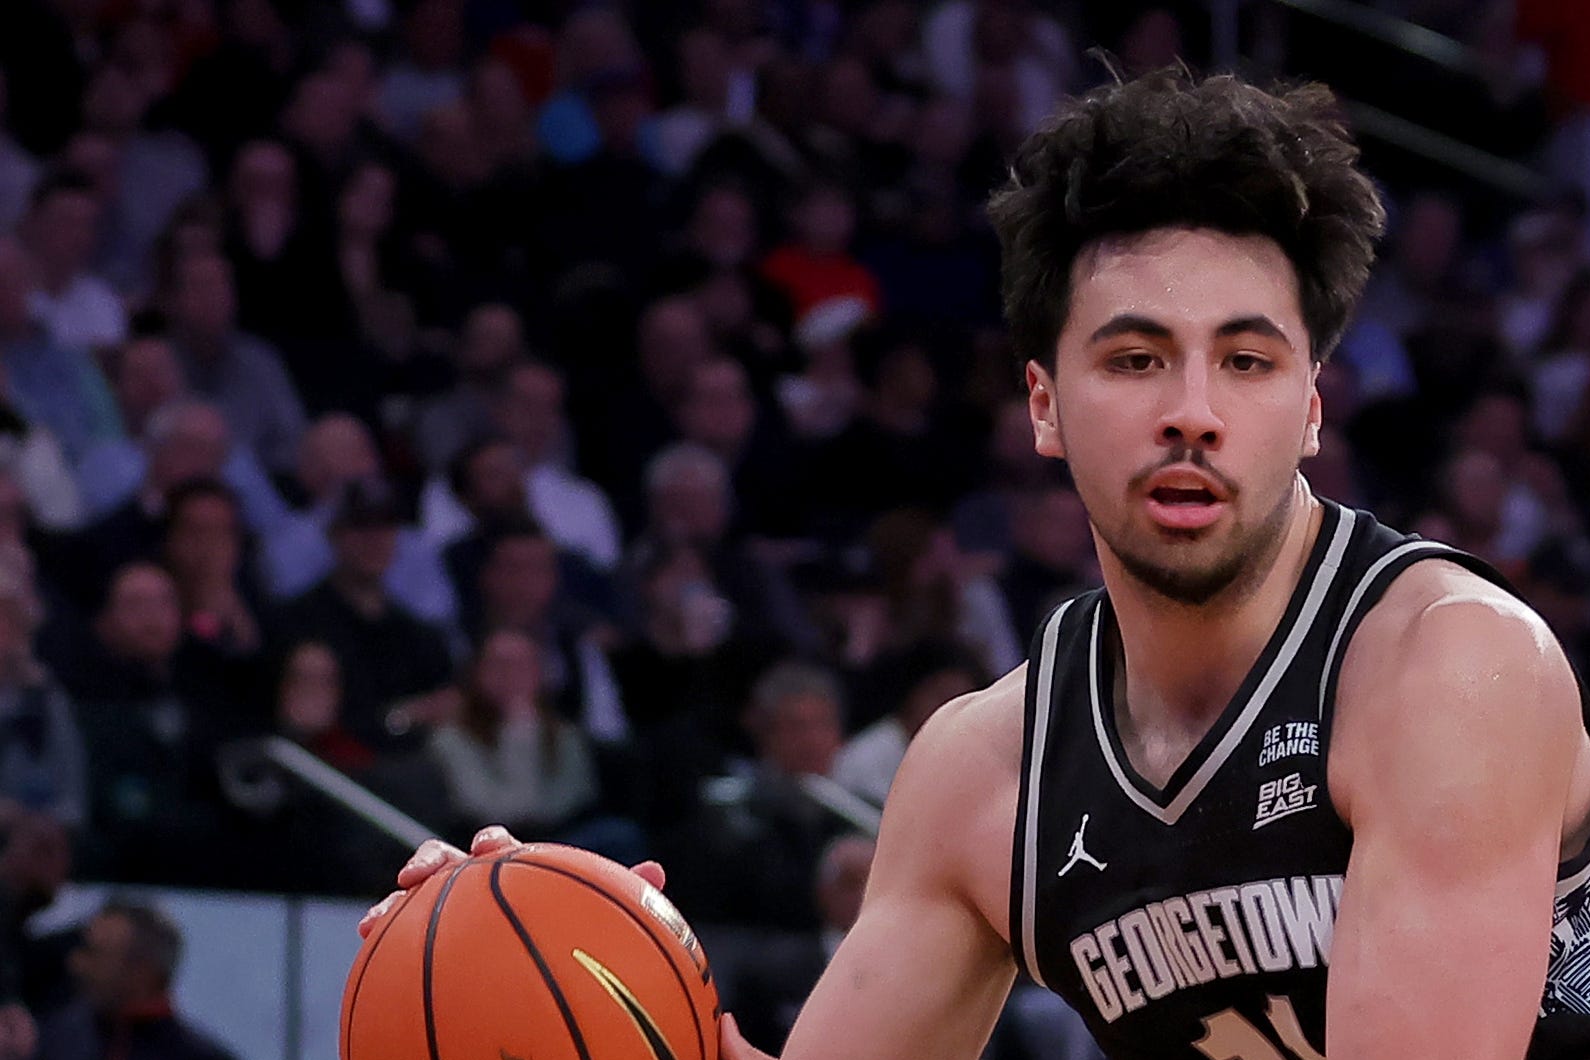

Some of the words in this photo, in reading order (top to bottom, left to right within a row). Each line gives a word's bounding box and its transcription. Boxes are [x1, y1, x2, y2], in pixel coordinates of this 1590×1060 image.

[1263, 725, 1282, 749] BE
[1285, 722, 1319, 740] THE
[1258, 738, 1320, 768] CHANGE
[1255, 784, 1318, 820] EAST
[1258, 772, 1302, 803] BIG
